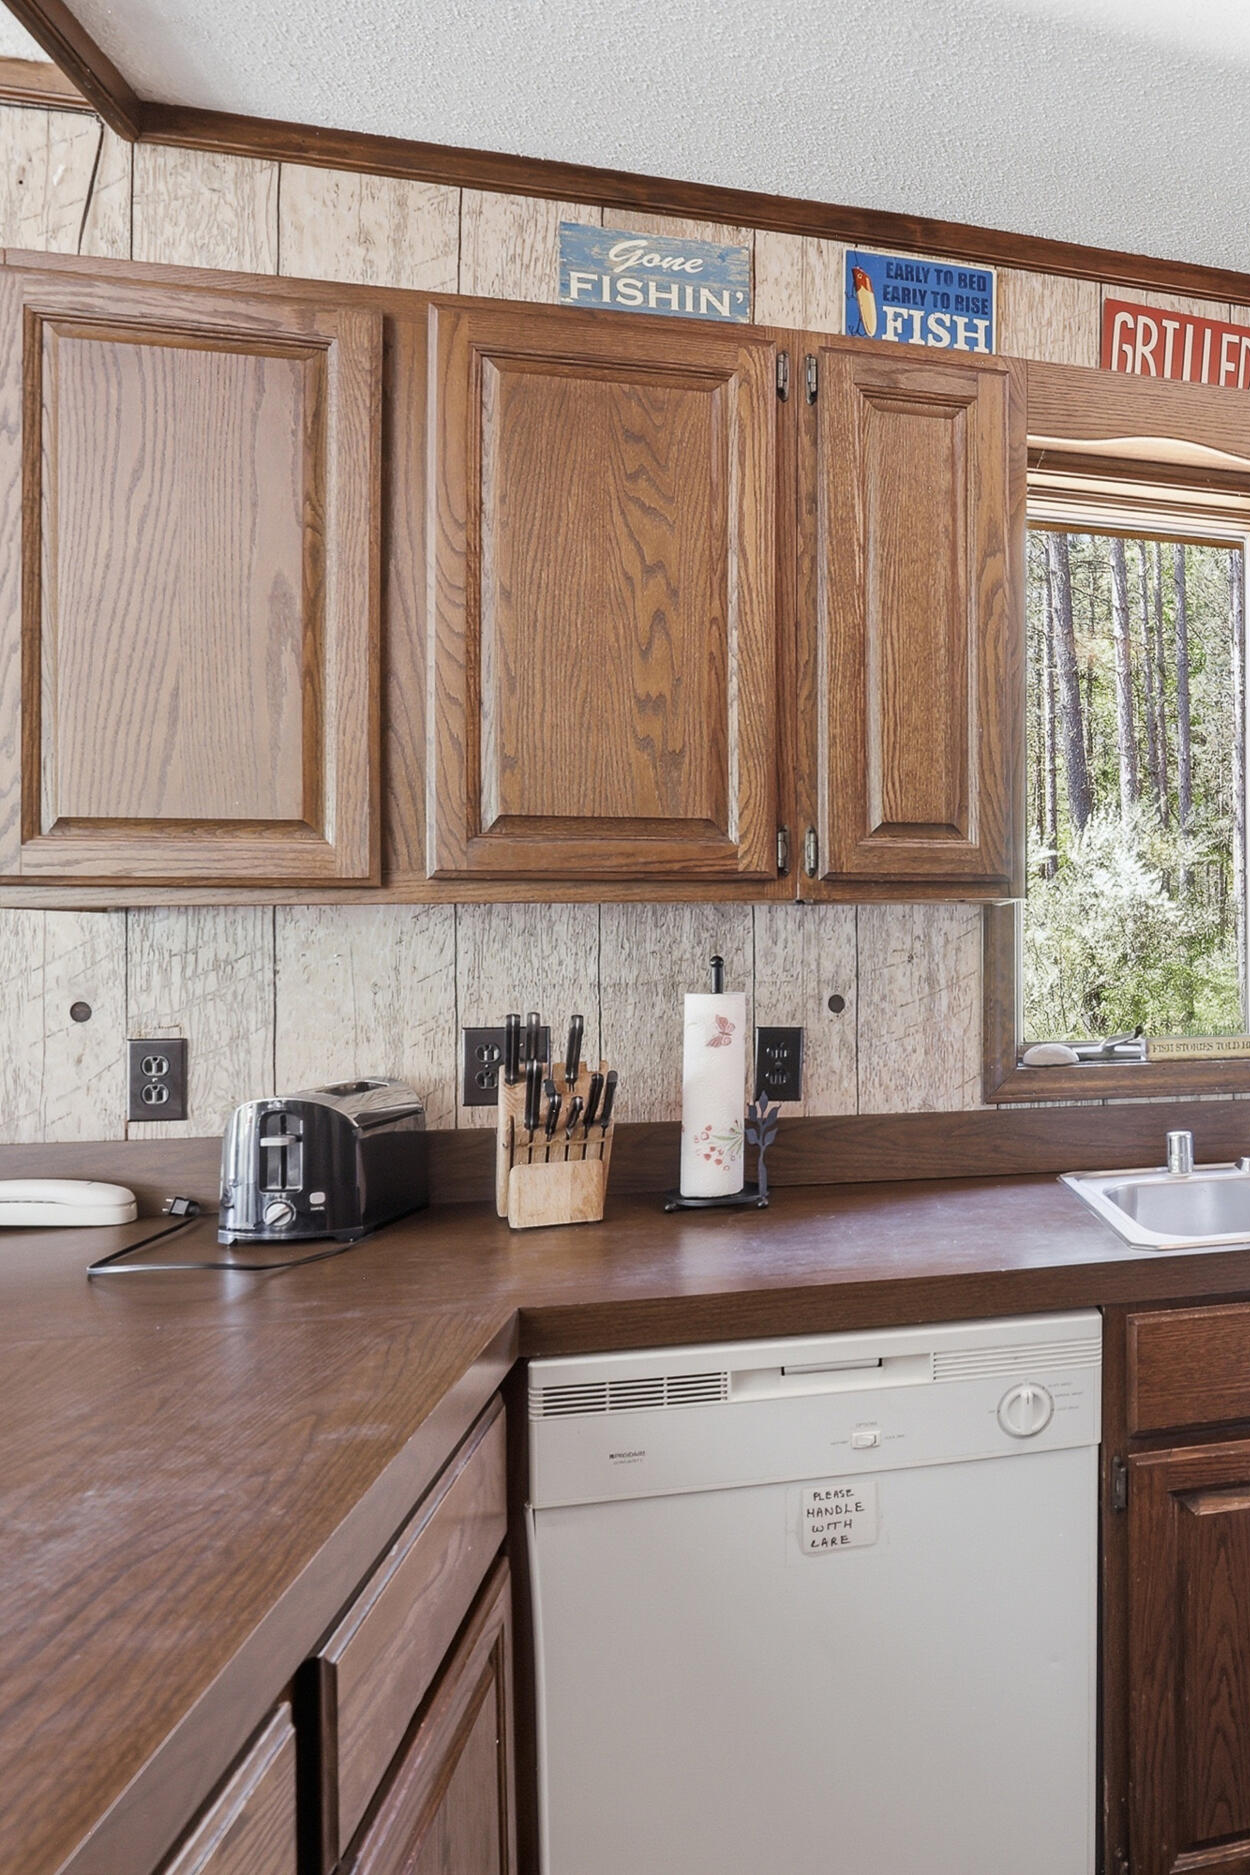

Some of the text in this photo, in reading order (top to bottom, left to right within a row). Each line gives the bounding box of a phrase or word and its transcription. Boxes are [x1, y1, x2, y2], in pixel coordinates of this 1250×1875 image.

[608, 239, 704, 273] Gone
[886, 262, 987, 292] EARLY TO BED
[568, 271, 744, 317] FISHIN'
[882, 285, 989, 315] EARLY TO RISE
[881, 306, 990, 353] FISH
[1216, 1040, 1241, 1051] TOLD
[813, 1489, 854, 1501] PLEASE
[806, 1501, 864, 1518] HANDLE
[811, 1519, 853, 1533] WITH
[811, 1535, 851, 1548] CARE
